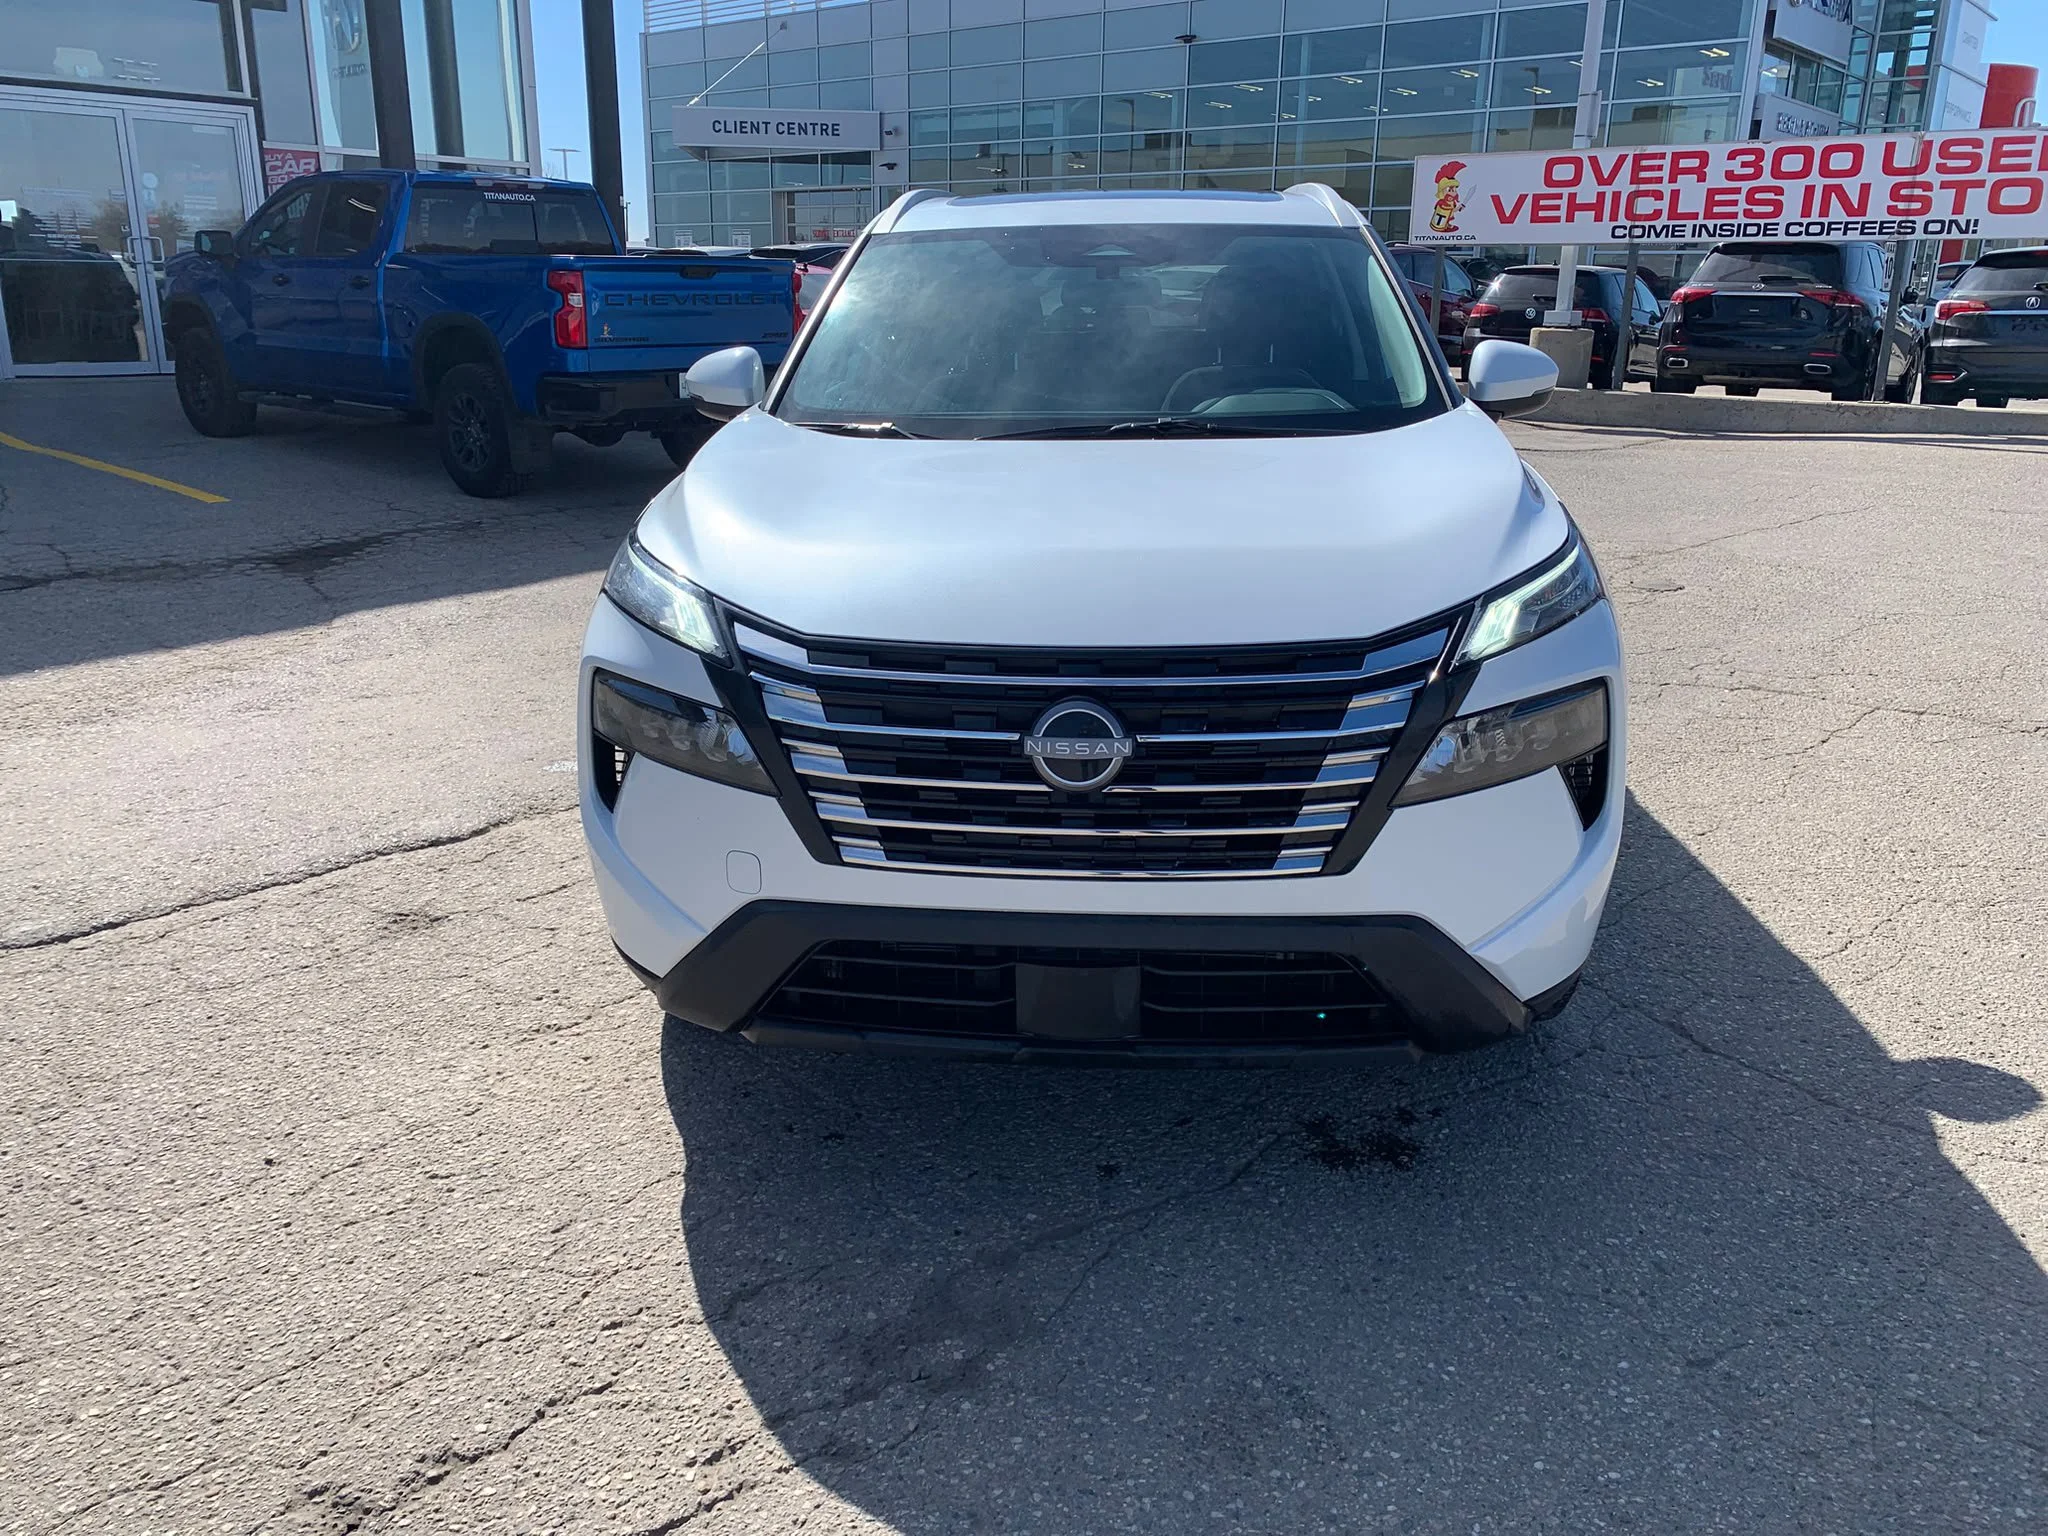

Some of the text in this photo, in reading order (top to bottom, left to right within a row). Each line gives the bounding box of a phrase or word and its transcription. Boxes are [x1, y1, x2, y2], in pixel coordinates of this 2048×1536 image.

[712, 119, 841, 137] CLIENT CENTRE
[265, 158, 316, 176] CAR
[1543, 135, 2048, 188] OVER 300 USE
[483, 192, 537, 202] TITANAUTO.CA
[1490, 186, 1785, 225] VEHICLES
[1800, 182, 1872, 218] IN
[1610, 218, 1980, 239] COME INSIDE COFFEES ON!
[604, 292, 785, 307] CHEVROLET
[1026, 740, 1129, 755] NISSAN
